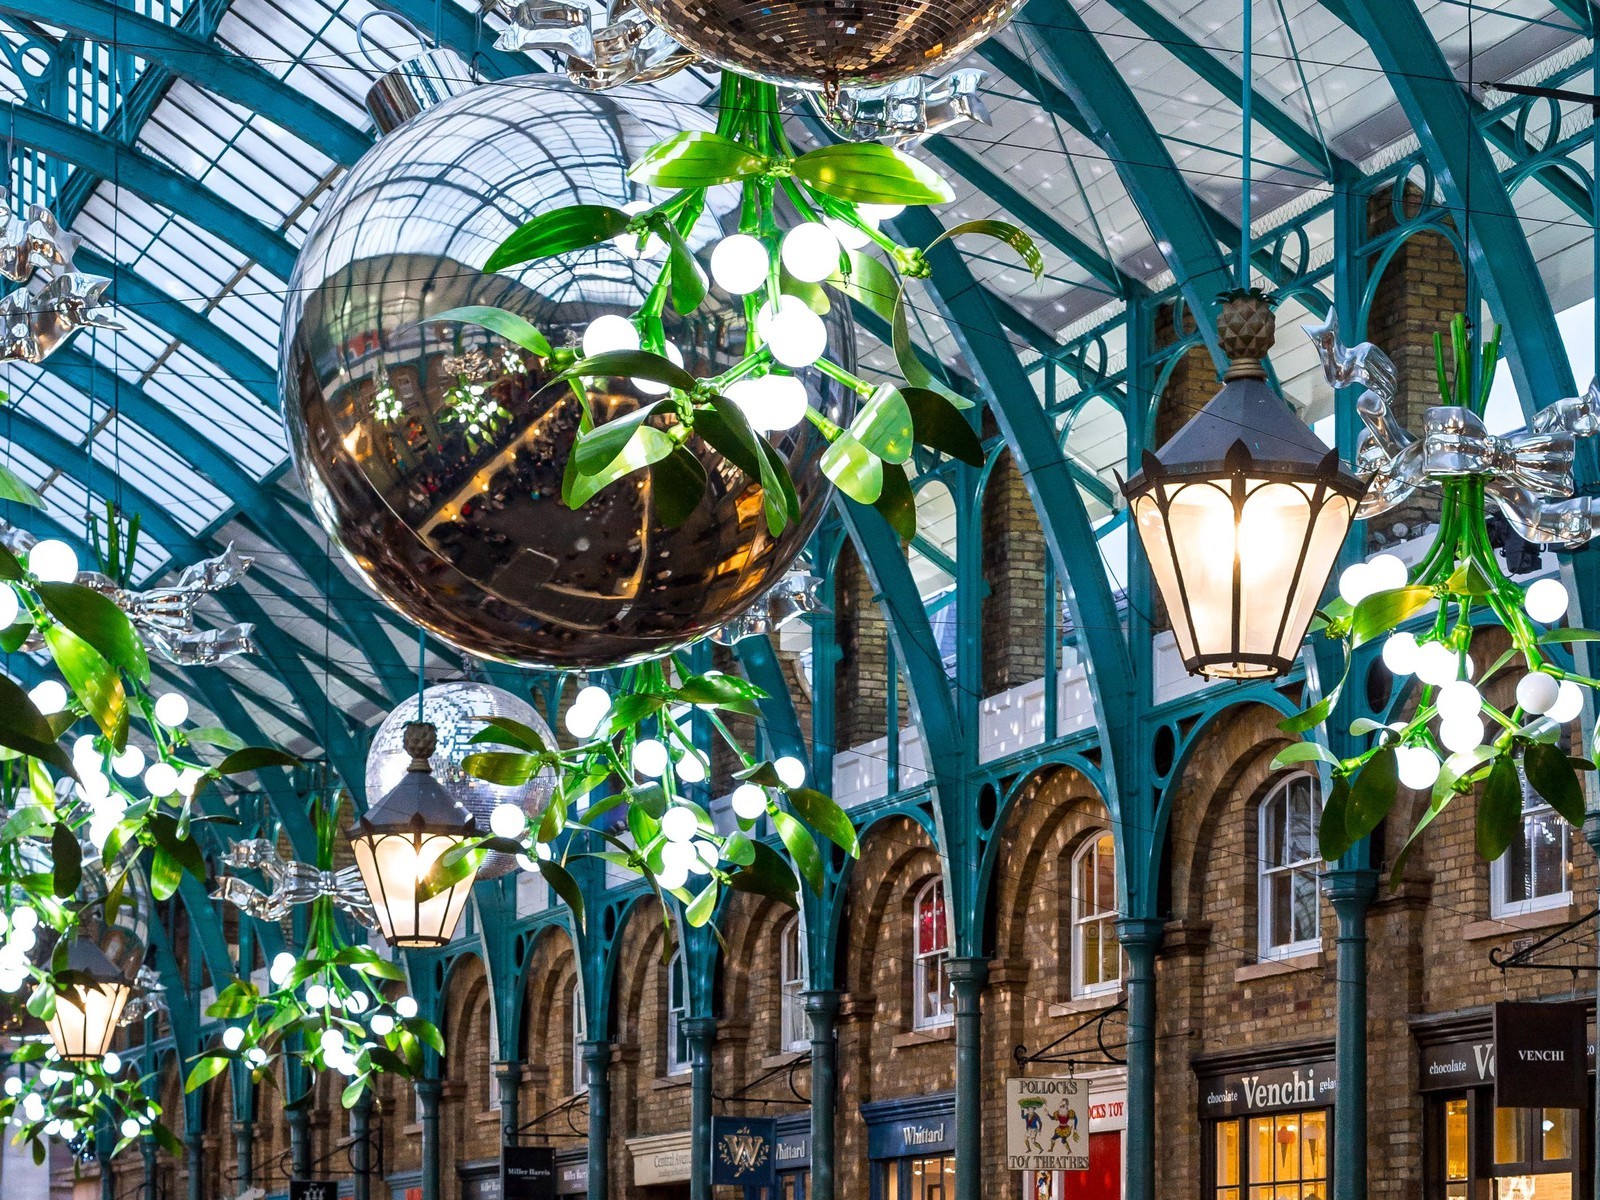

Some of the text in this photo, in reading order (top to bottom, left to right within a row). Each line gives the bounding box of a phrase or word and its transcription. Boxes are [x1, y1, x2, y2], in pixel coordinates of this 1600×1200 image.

[1518, 1050, 1565, 1062] VENCHI
[1429, 1060, 1467, 1075] chocolate
[1207, 1090, 1238, 1104] chocolate
[1241, 1068, 1315, 1109] Venchi
[1109, 1102, 1124, 1117] TOY
[902, 1123, 944, 1146] Whittard
[1010, 1156, 1089, 1169] TOY THEATRES
[508, 1167, 551, 1176] Miller Harris
